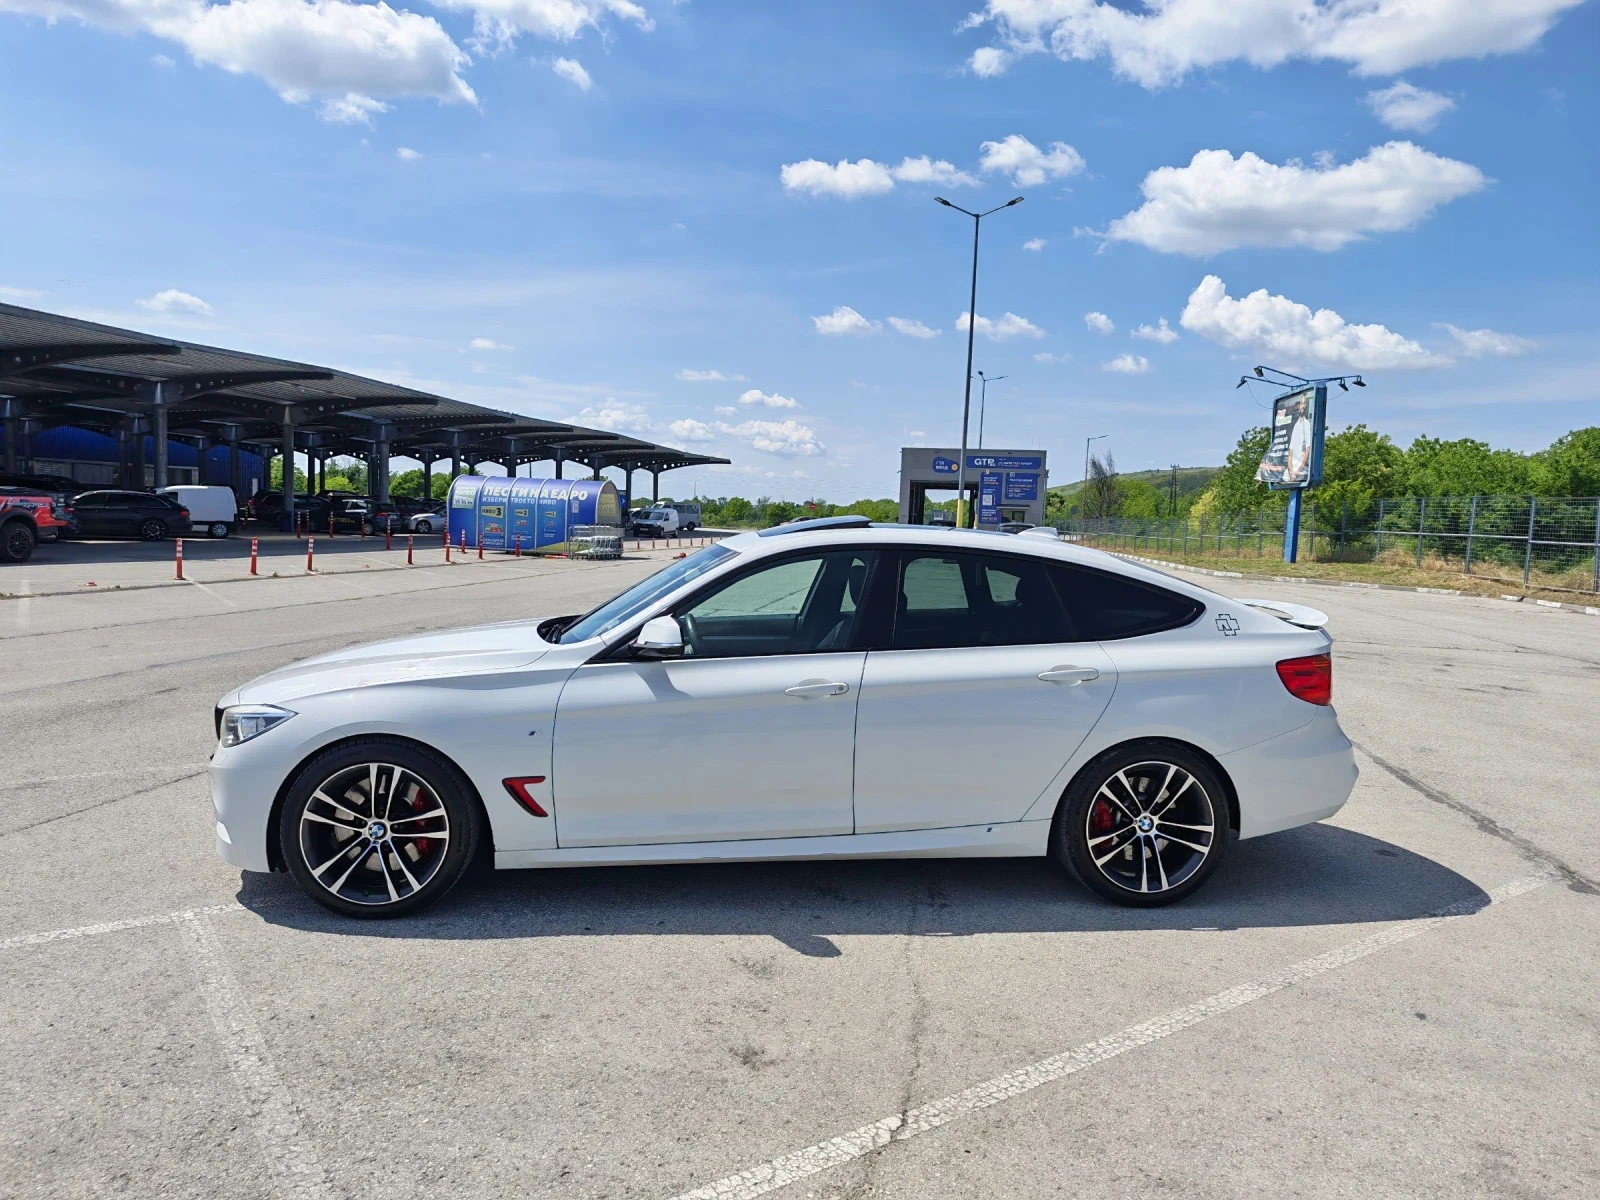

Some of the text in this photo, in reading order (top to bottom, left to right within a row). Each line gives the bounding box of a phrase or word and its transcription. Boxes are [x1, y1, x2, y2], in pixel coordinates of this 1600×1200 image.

[974, 458, 994, 466] GTP
[484, 487, 528, 498] ПЕСТИ
[529, 488, 549, 498] НА
[550, 489, 588, 500] ЕДРО
[496, 508, 502, 516] 3
